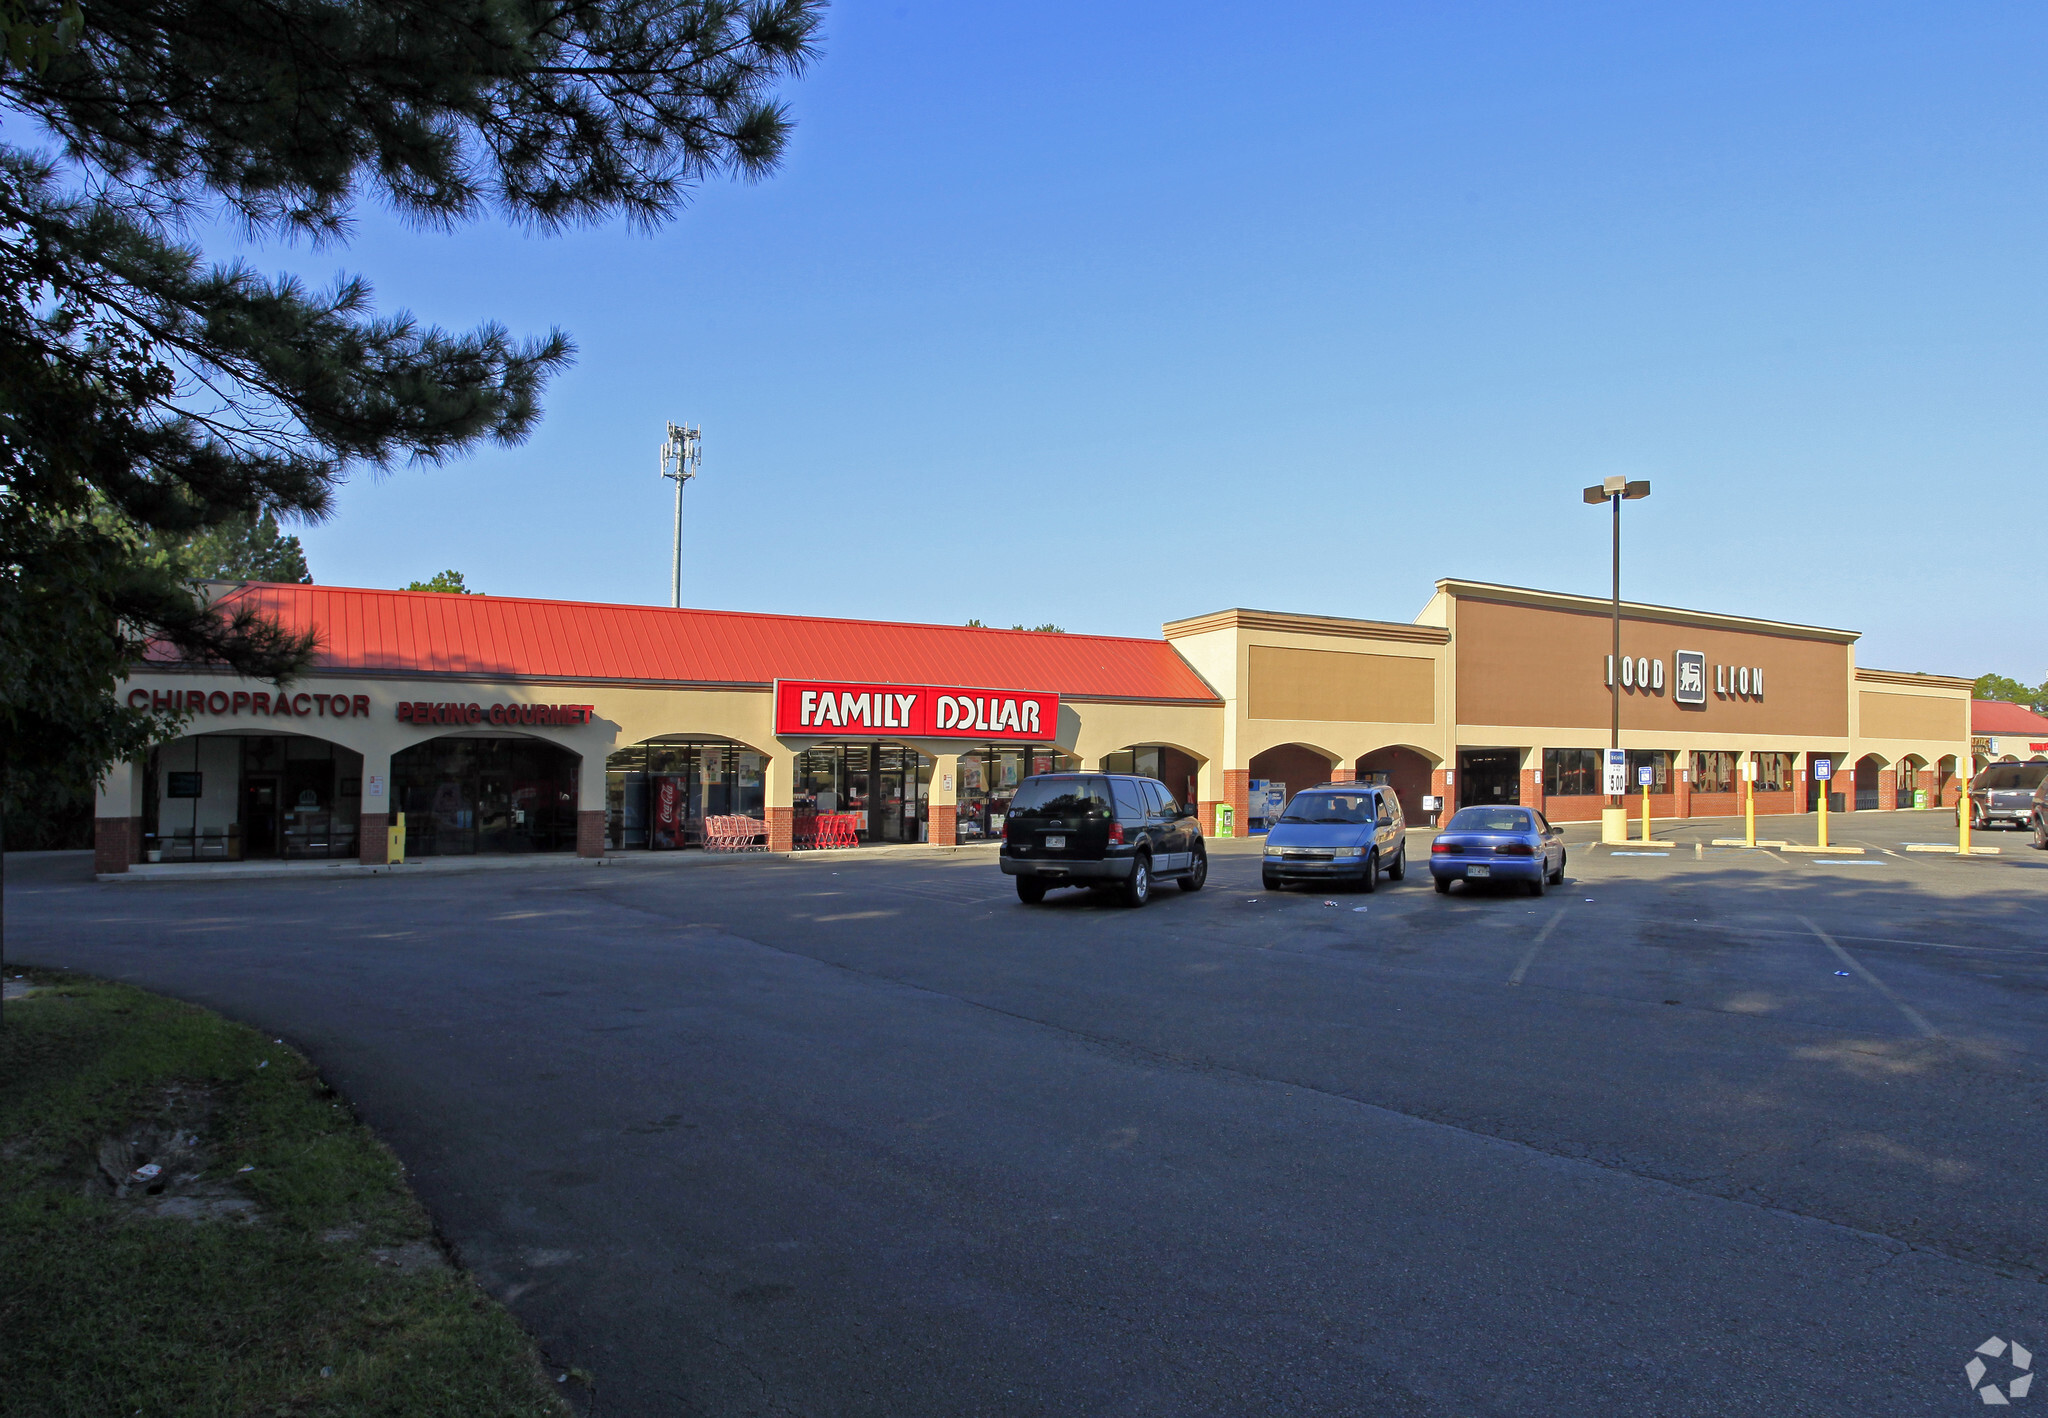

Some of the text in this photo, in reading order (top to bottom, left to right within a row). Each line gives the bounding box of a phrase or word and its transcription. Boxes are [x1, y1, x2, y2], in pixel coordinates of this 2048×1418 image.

[1717, 665, 1763, 695] LION
[127, 688, 370, 717] CHIROPRACTOR
[397, 702, 594, 725] PEKING GOURMET
[801, 690, 1041, 733] FAMILY DOLLAR
